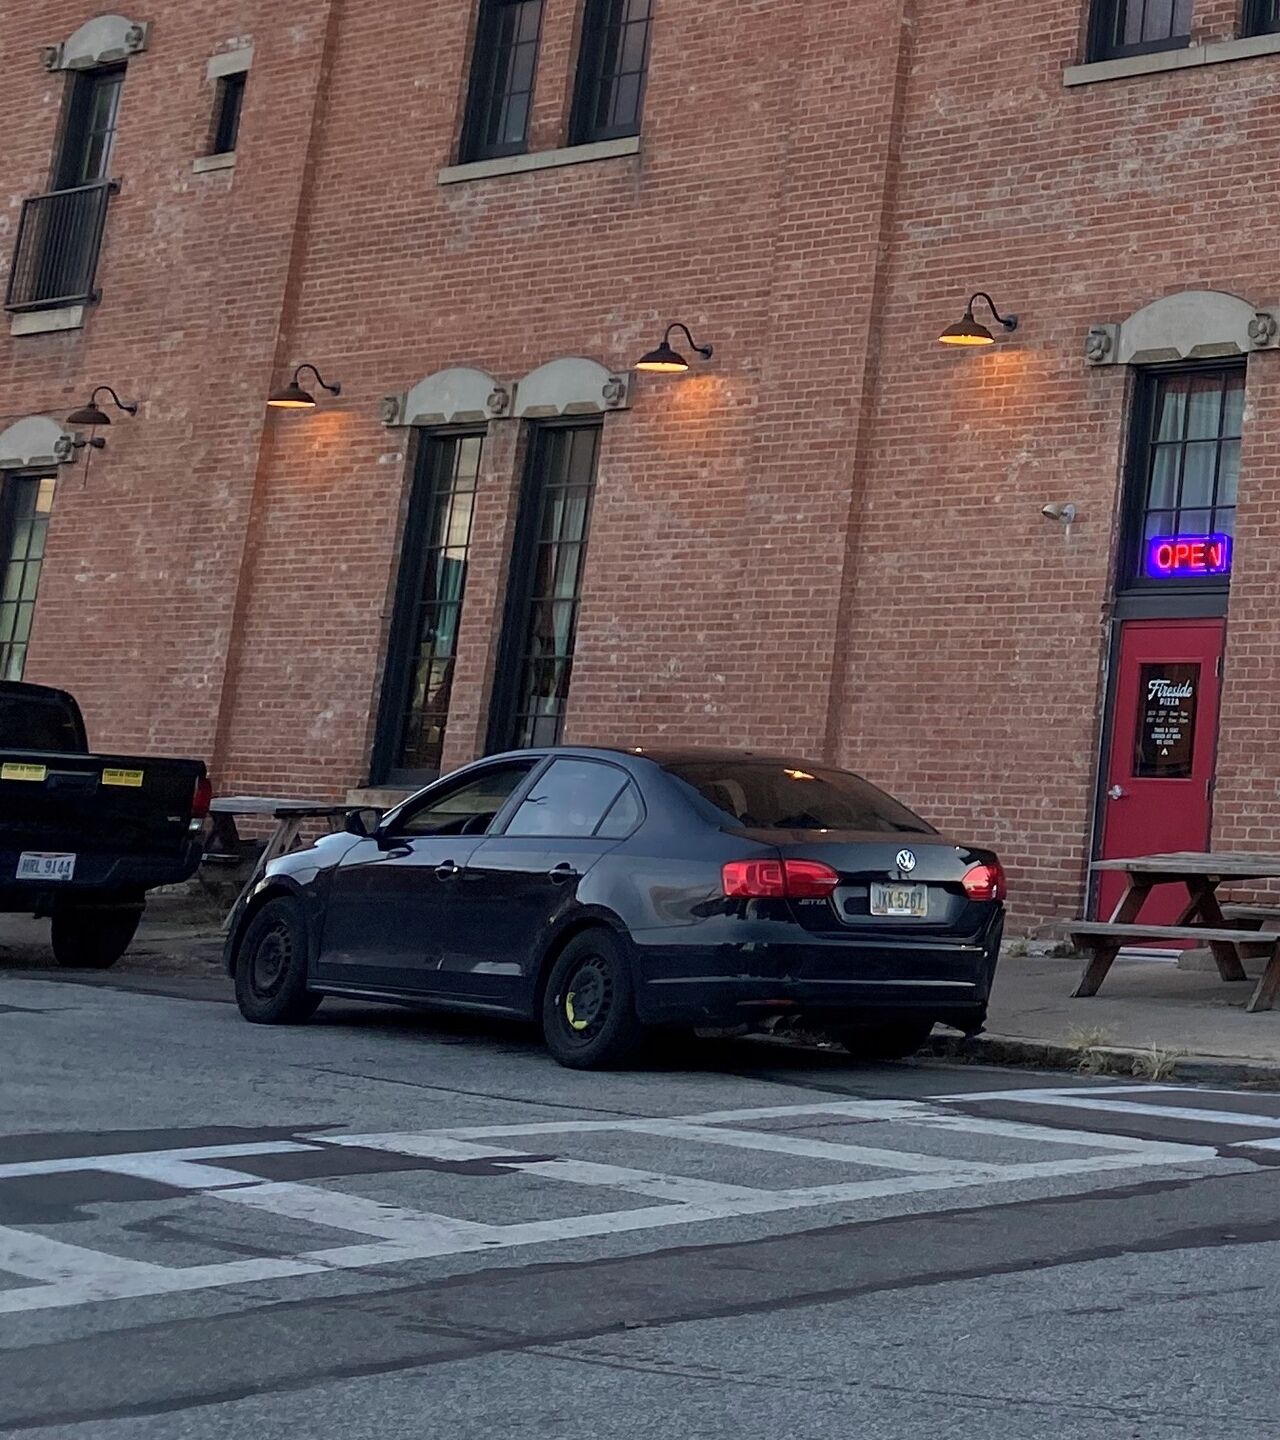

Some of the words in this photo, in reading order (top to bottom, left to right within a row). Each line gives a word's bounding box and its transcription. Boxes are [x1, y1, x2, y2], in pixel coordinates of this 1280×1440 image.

[1157, 543, 1222, 568] OPEN
[1147, 679, 1193, 701] Fireside
[1159, 698, 1180, 706] PIZZA
[44, 860, 72, 875] 9144
[798, 898, 827, 906] JETTA
[897, 891, 923, 910] 5267
